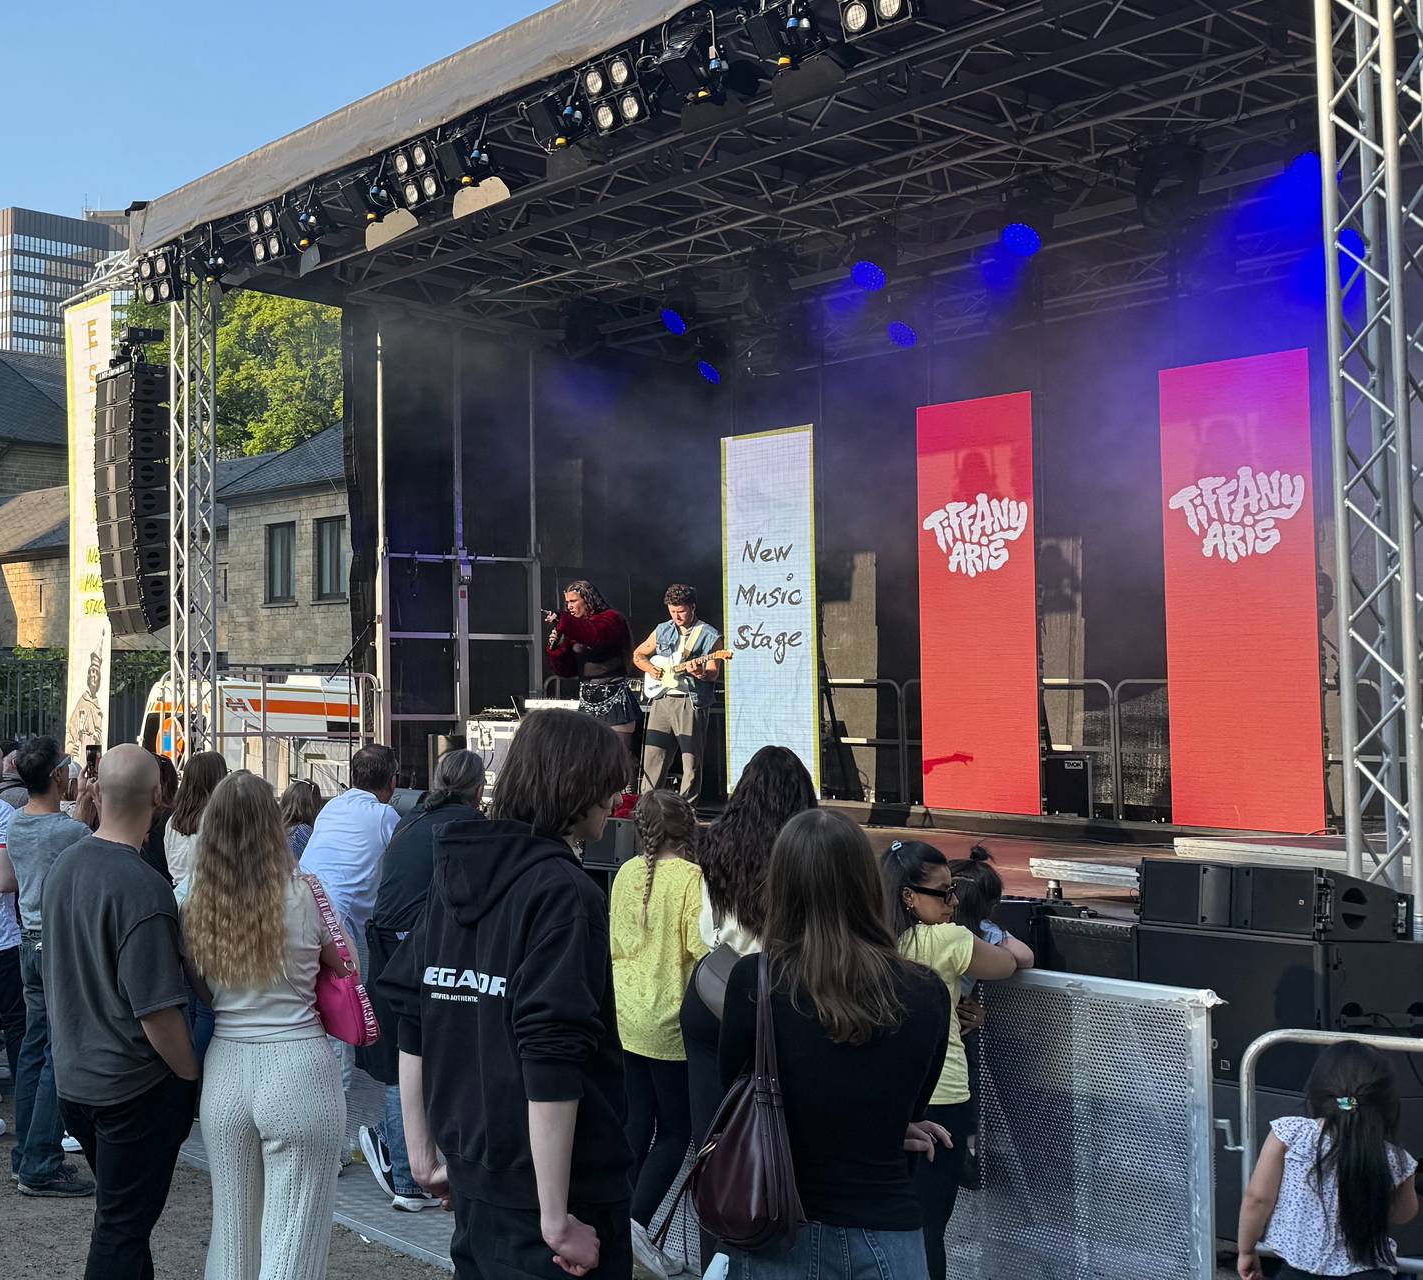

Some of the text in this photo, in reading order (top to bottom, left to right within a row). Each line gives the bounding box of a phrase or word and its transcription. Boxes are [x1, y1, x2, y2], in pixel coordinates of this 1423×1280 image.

[742, 537, 793, 563] New
[735, 572, 803, 608] Music
[733, 621, 802, 664] Stage
